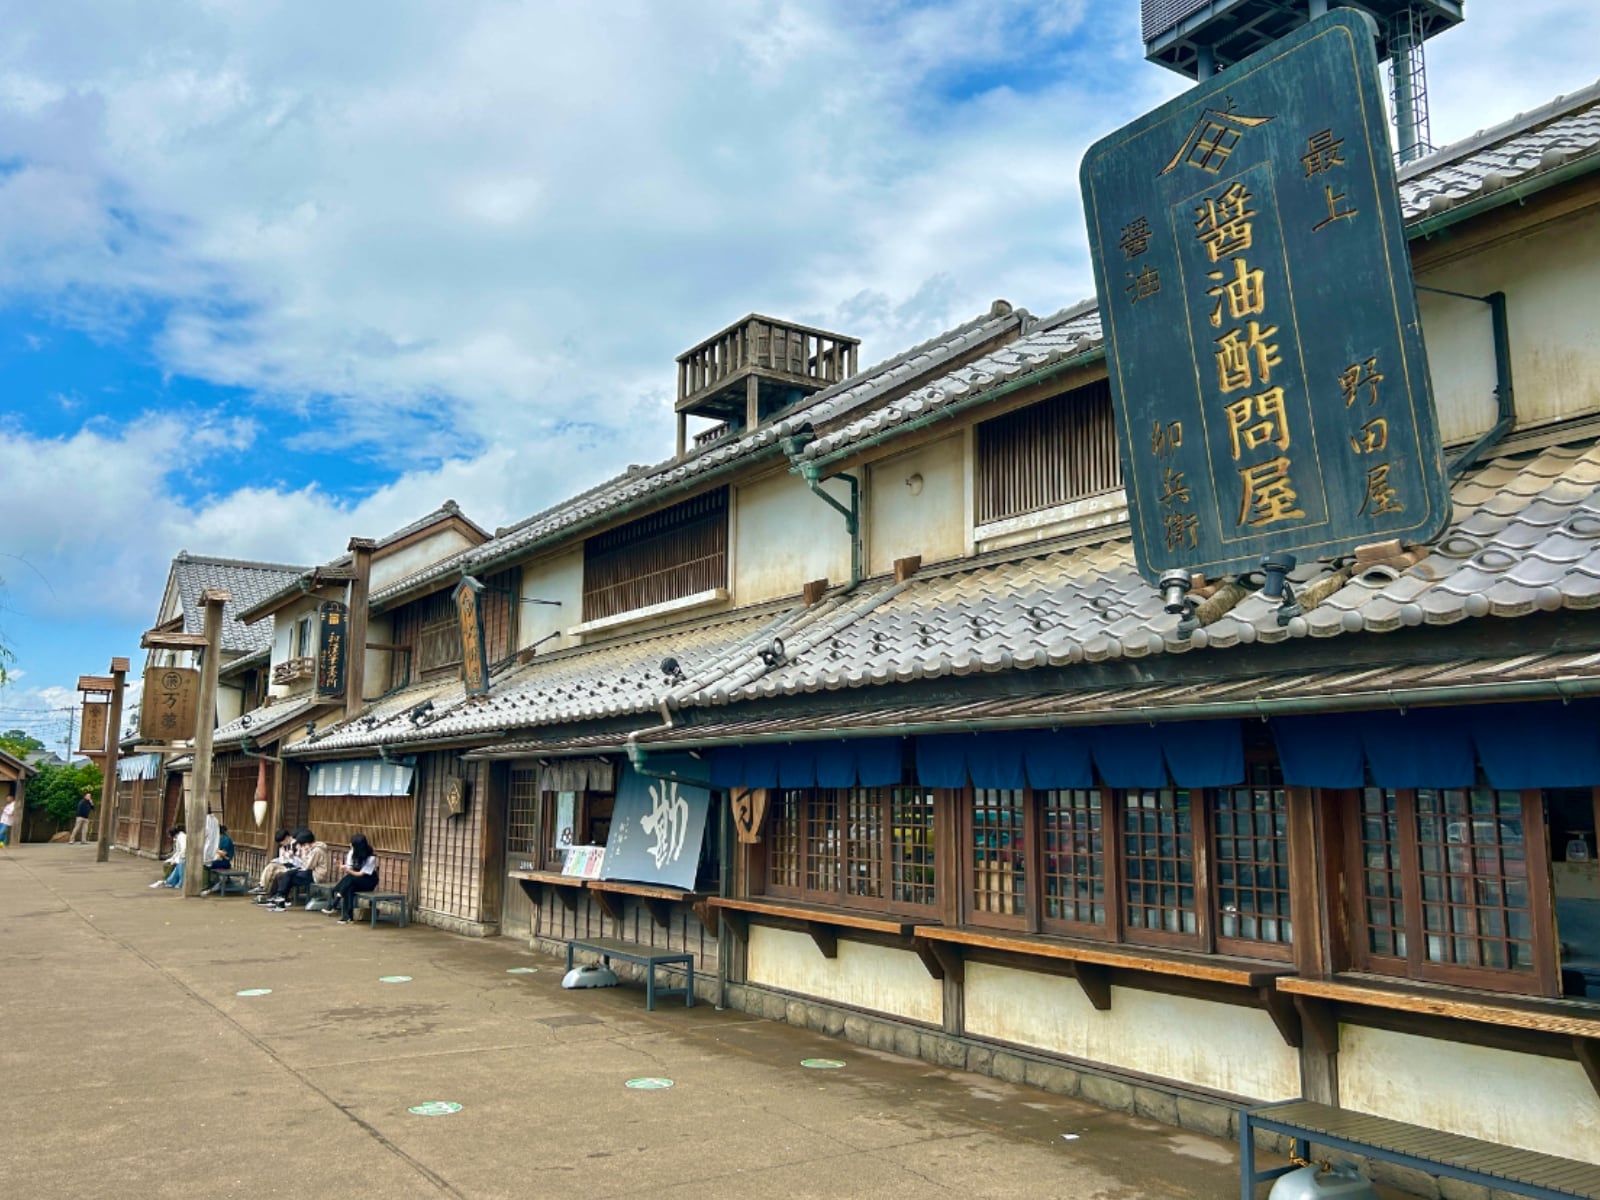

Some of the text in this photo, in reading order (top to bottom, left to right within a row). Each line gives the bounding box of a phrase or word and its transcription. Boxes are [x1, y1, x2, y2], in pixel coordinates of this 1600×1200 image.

[1300, 128, 1359, 232] 最上
[1194, 182, 1306, 528] 醤油酢問屋
[1338, 356, 1405, 518] 野田屋
